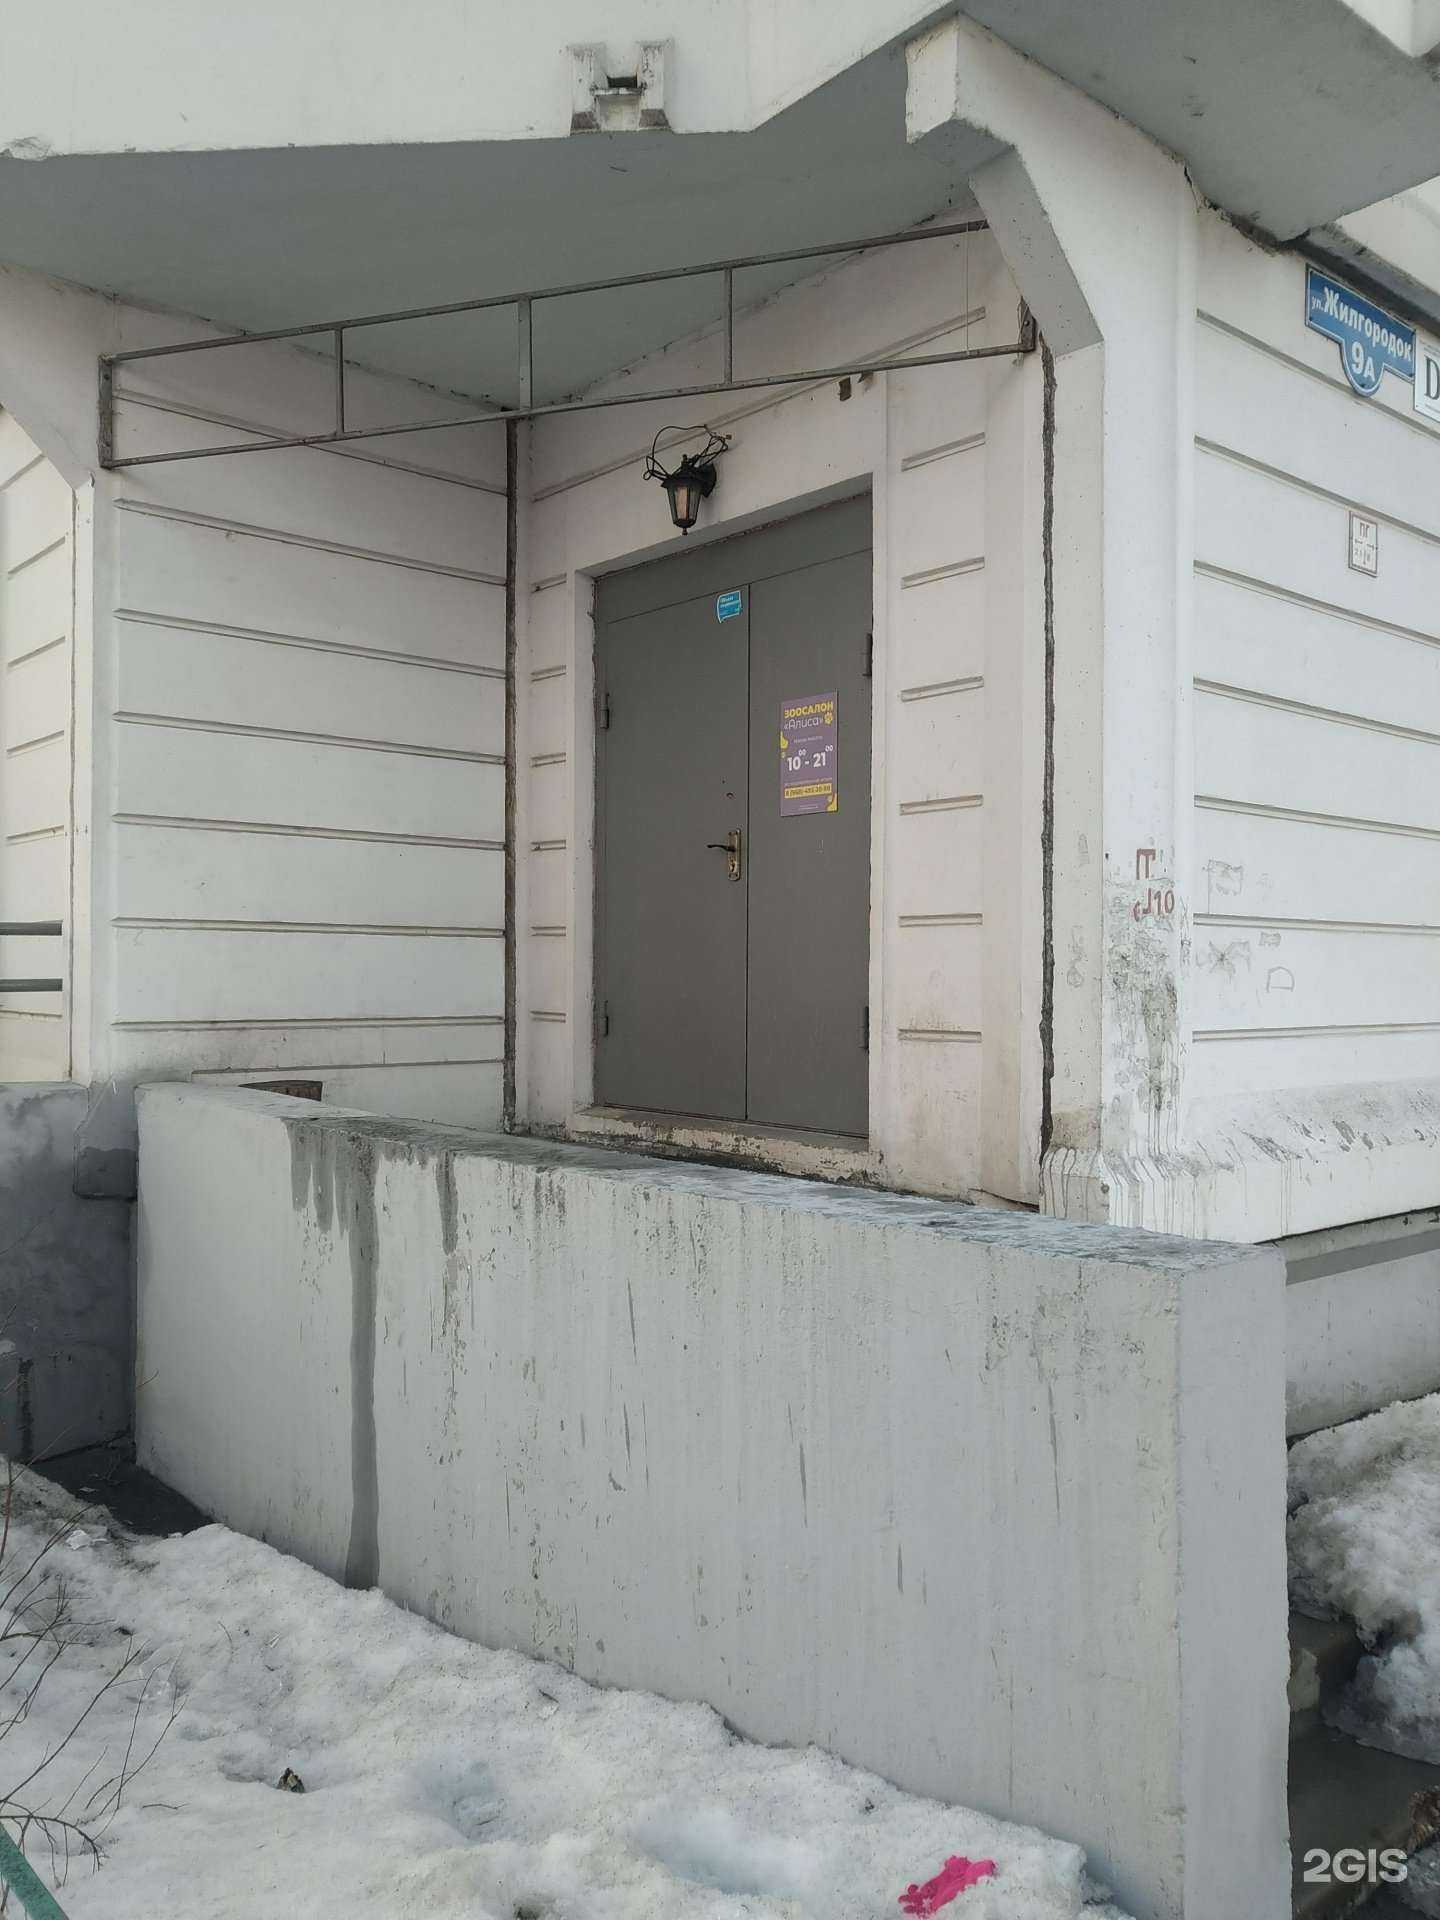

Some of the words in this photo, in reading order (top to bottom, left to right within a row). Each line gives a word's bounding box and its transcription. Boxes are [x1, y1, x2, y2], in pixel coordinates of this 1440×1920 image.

[1311, 296, 1324, 312] ул.
[1324, 287, 1412, 362] Жилгородок
[1351, 341, 1376, 382] 9А
[784, 701, 834, 719] ЗООСАЛОН
